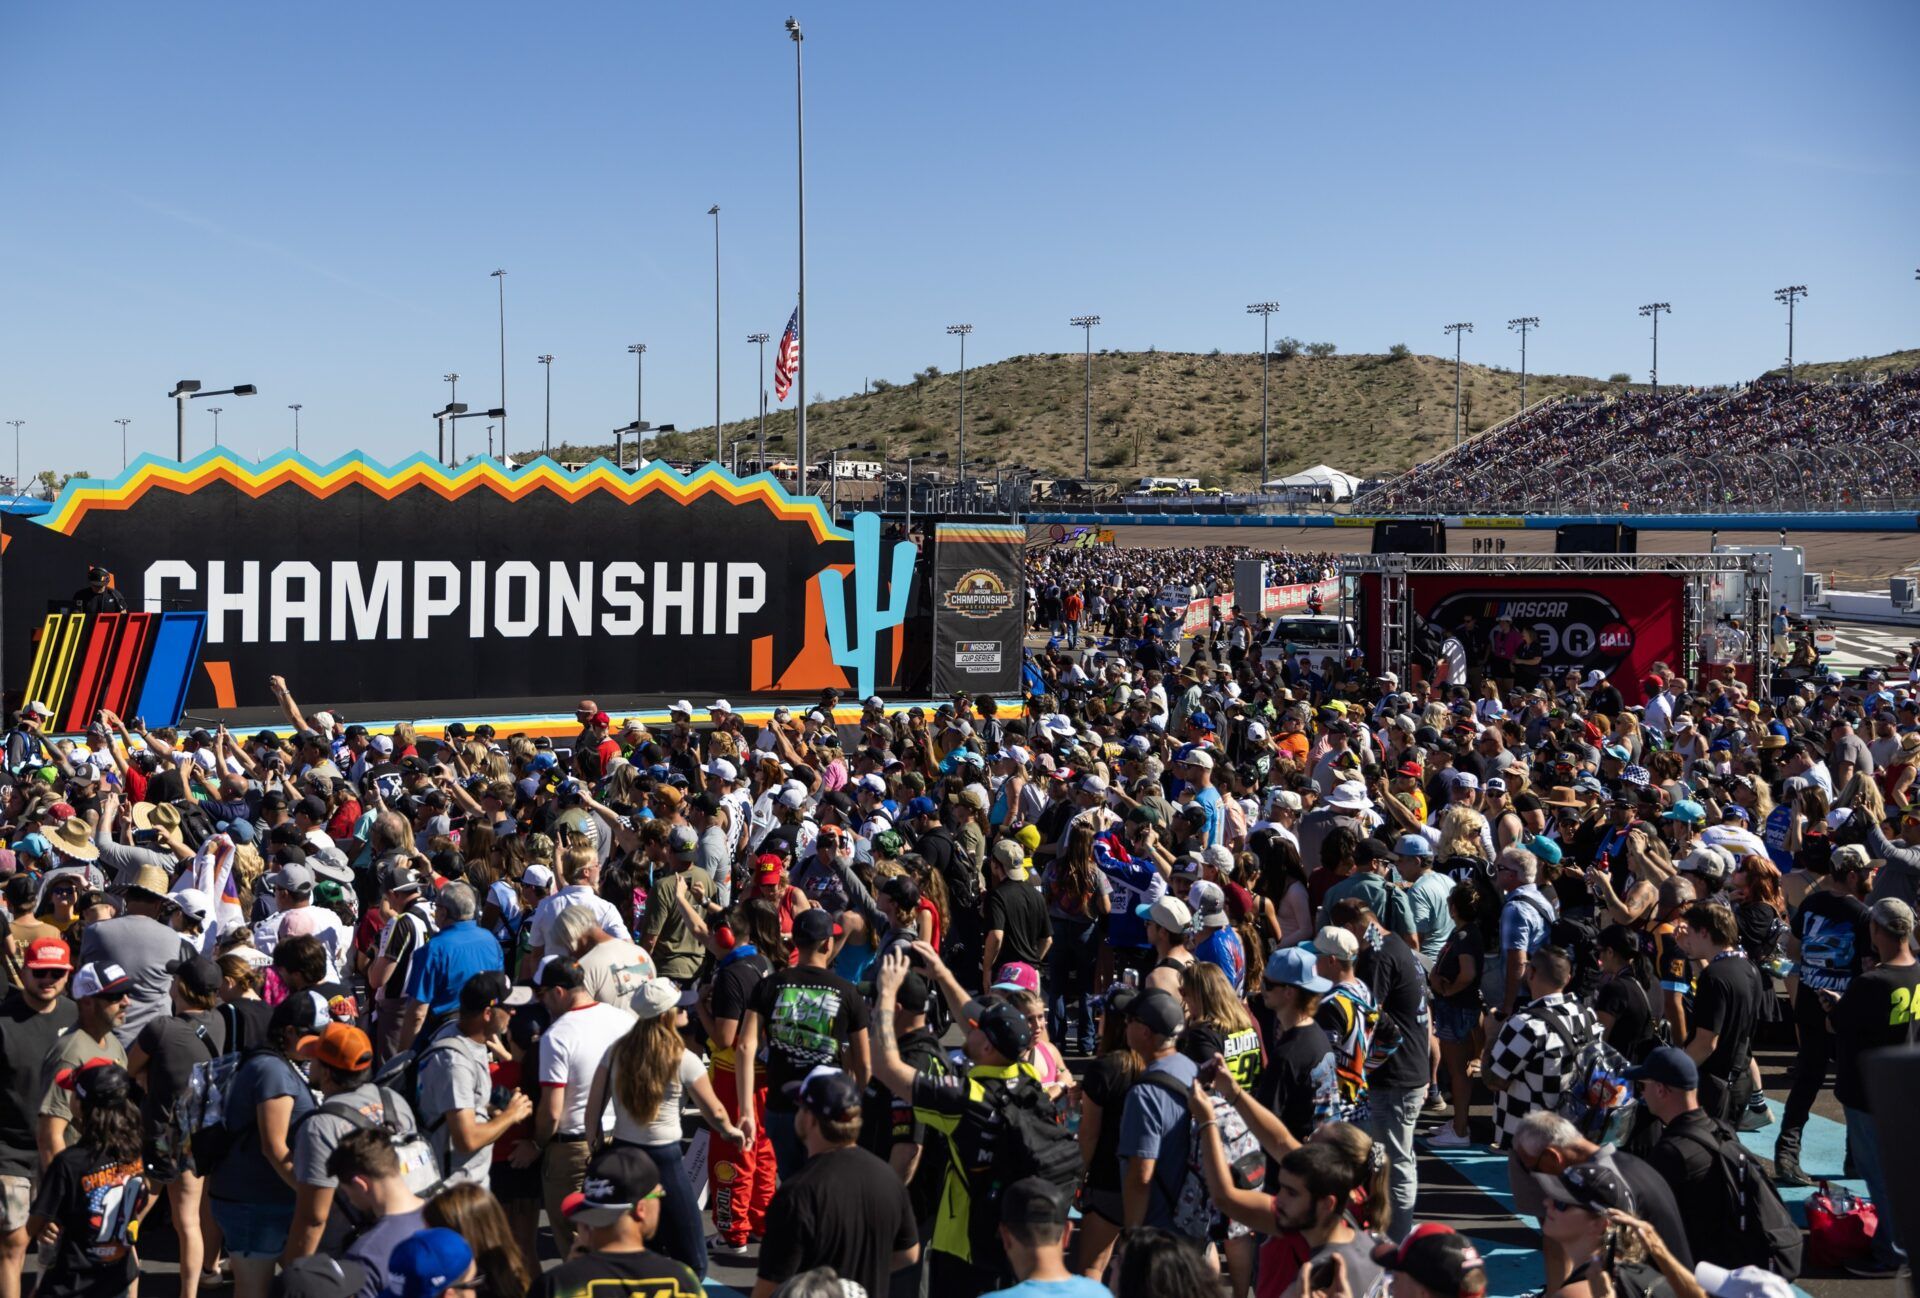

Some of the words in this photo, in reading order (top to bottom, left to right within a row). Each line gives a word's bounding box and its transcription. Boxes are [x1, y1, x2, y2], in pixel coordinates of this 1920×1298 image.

[1075, 533, 1097, 548] 24
[144, 560, 767, 643] CHAMPIONSHIP
[951, 595, 1008, 604] CHAMPIONSHIP
[1503, 602, 1568, 617] NASCAR
[969, 643, 995, 651] NASCAR
[1600, 632, 1630, 647] BALL
[961, 654, 973, 662] CUP
[974, 654, 995, 662] SERIES
[775, 990, 841, 1017] LIME
[1889, 983, 1920, 1026] 24
